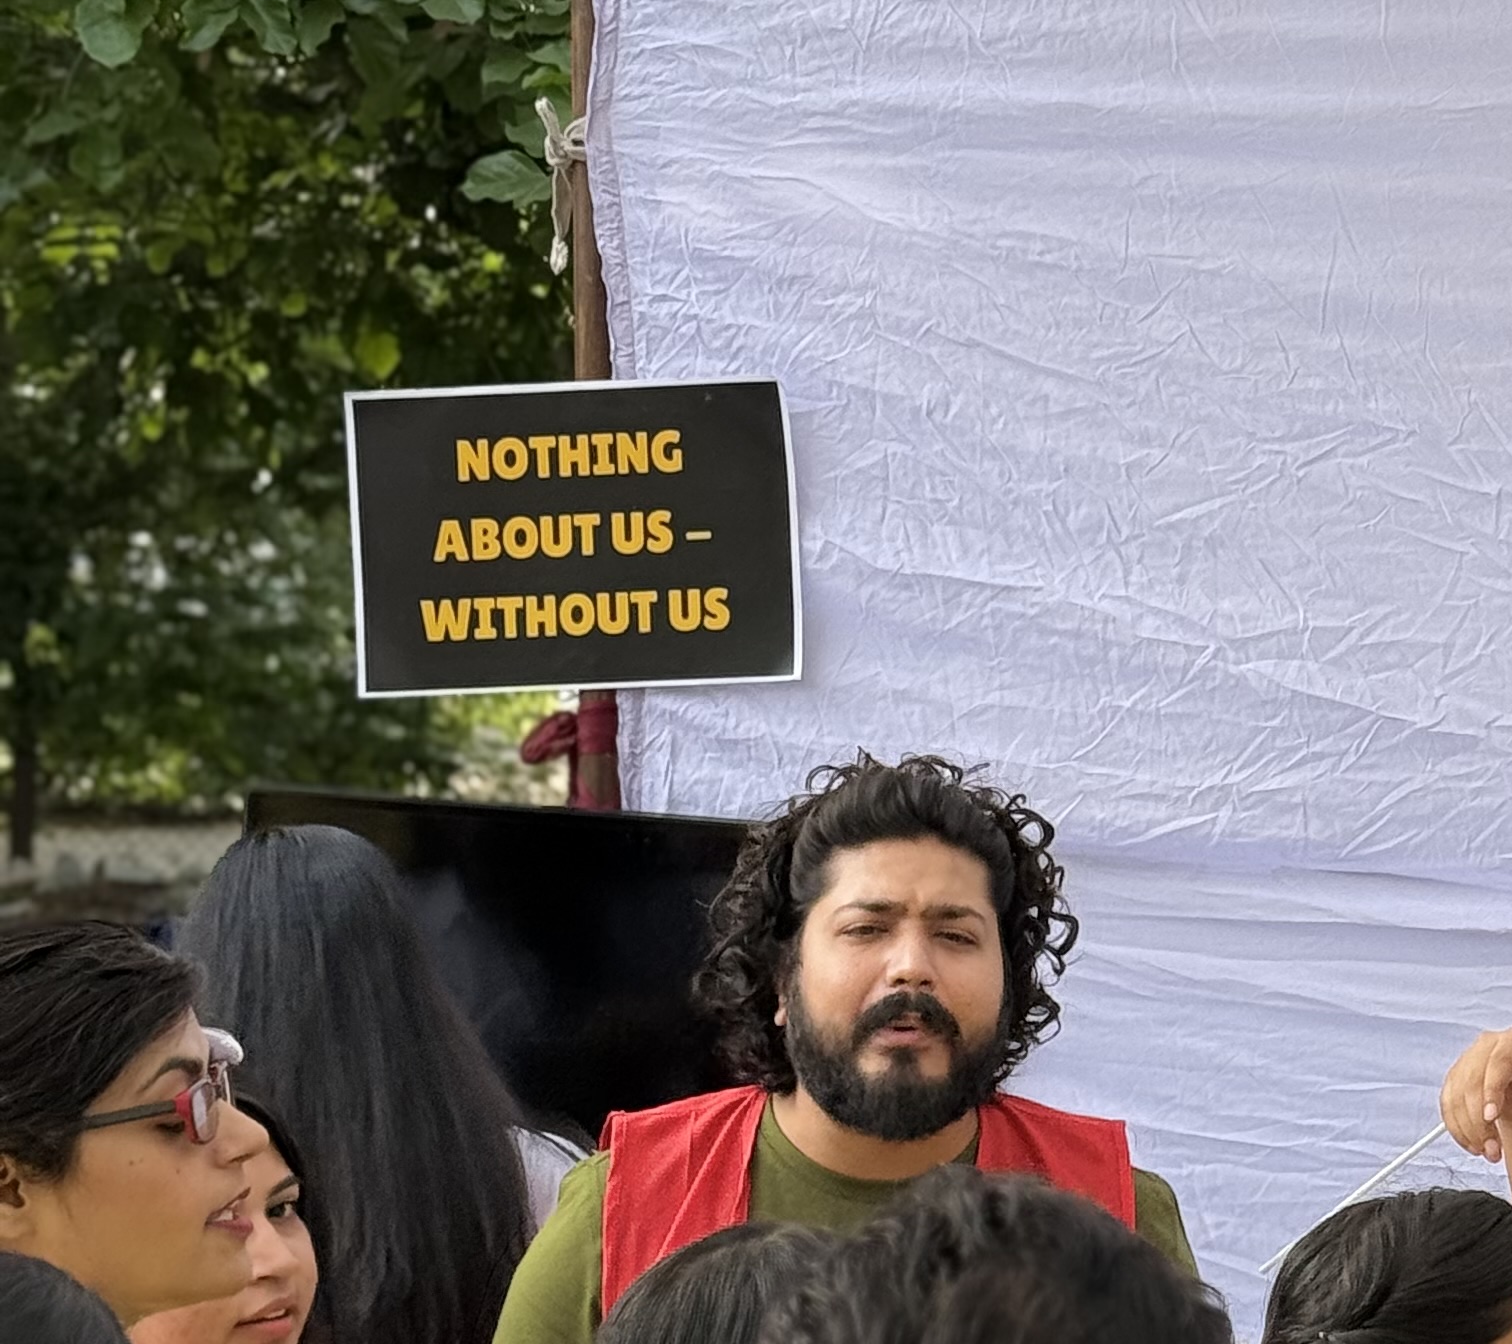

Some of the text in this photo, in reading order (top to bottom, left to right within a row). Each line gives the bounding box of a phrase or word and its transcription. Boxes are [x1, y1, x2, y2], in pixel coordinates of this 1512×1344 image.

[455, 429, 684, 483] NOTHING
[433, 513, 600, 563] ABOUT
[611, 509, 674, 555] US
[419, 587, 731, 643] WITHOUT US
